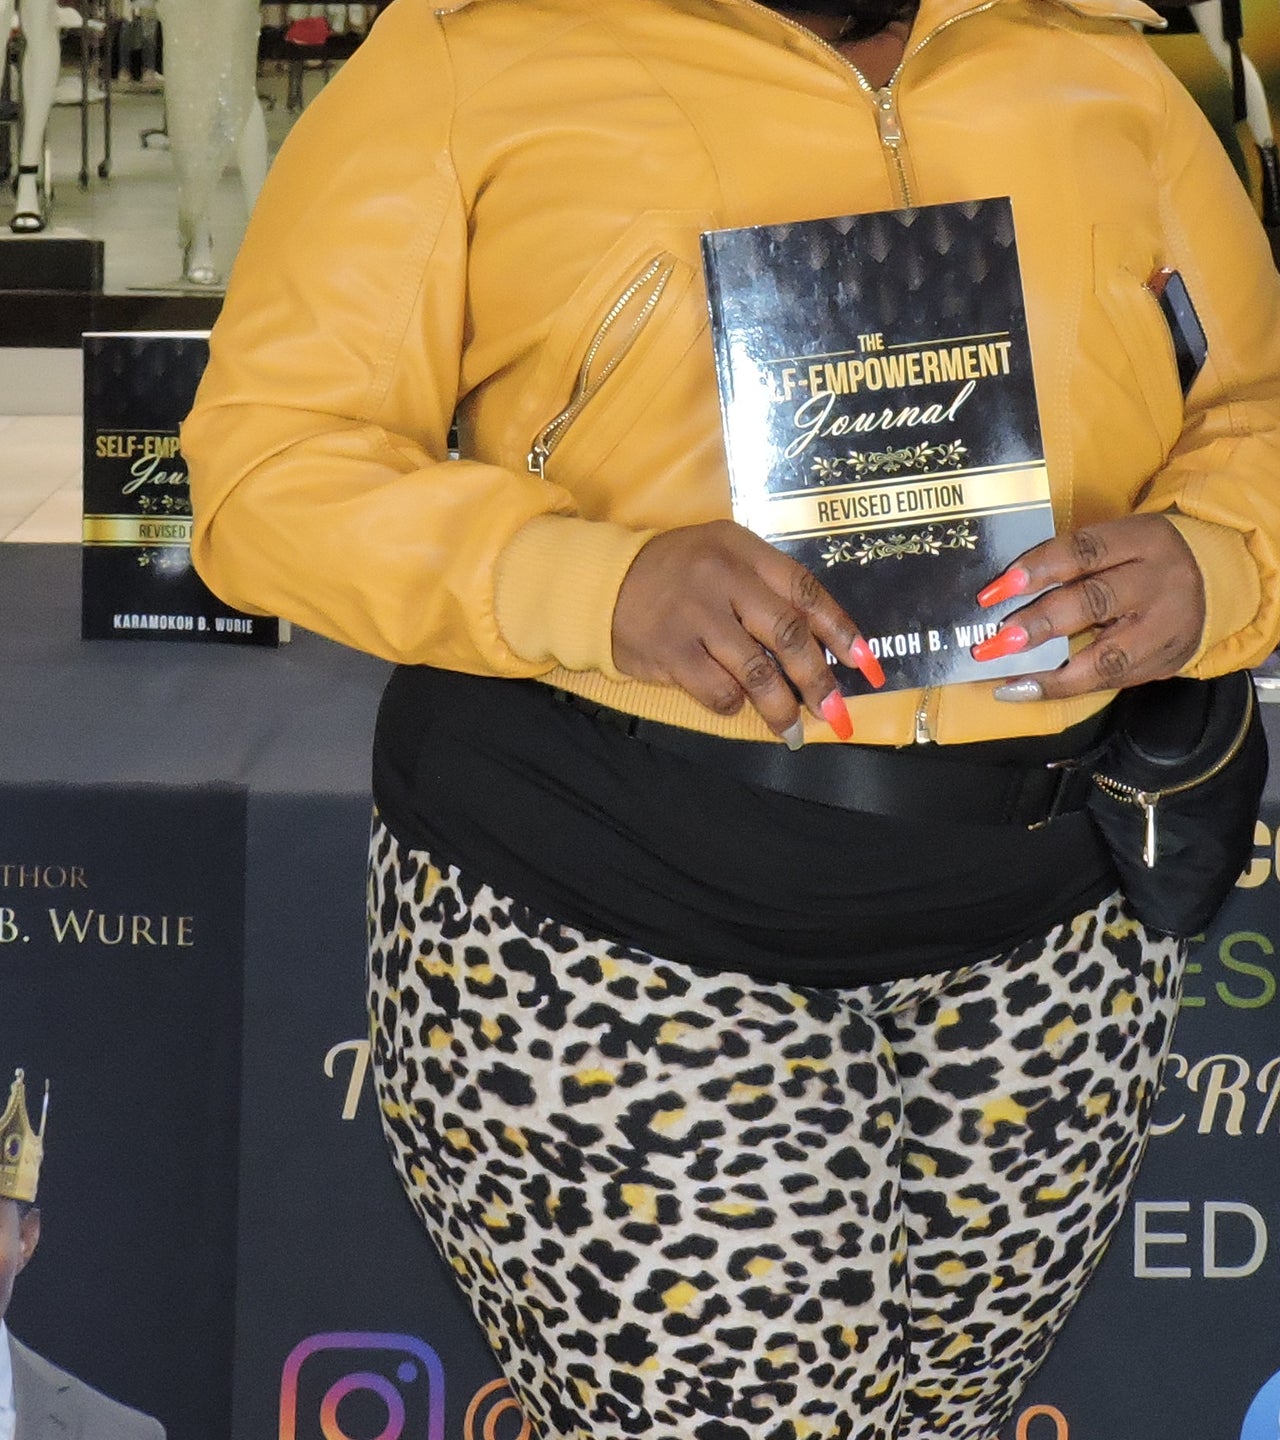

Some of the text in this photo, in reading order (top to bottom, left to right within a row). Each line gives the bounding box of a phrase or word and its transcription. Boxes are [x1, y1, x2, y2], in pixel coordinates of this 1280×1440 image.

[857, 332, 885, 353] THE
[784, 380, 977, 459] Journal
[817, 484, 964, 522] REVISED EDITION
[139, 524, 186, 539] REVISED
[113, 614, 253, 634] KARAMOKOH B. WURIE
[928, 630, 949, 652] B.
[48, 908, 195, 948] WURIE
